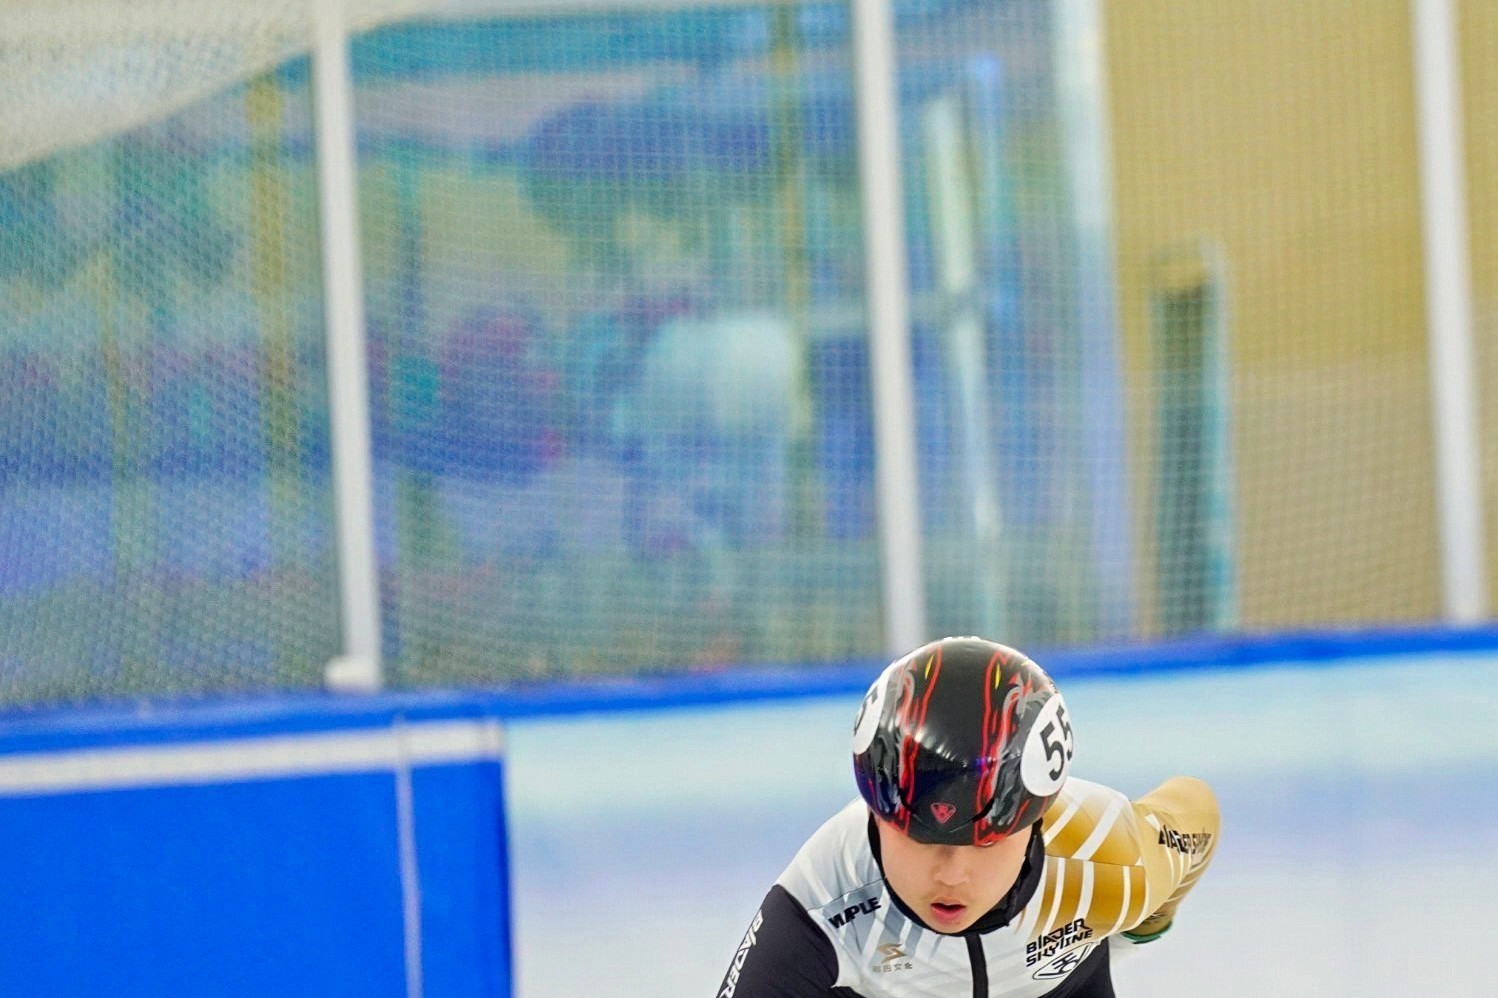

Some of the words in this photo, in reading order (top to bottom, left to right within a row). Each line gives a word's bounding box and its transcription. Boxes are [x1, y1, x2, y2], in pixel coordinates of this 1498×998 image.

[1039, 704, 1074, 782] 55
[1026, 918, 1093, 955] BLADER
[1026, 931, 1094, 968] SKYLINE
[872, 962, 912, 973] 文化
